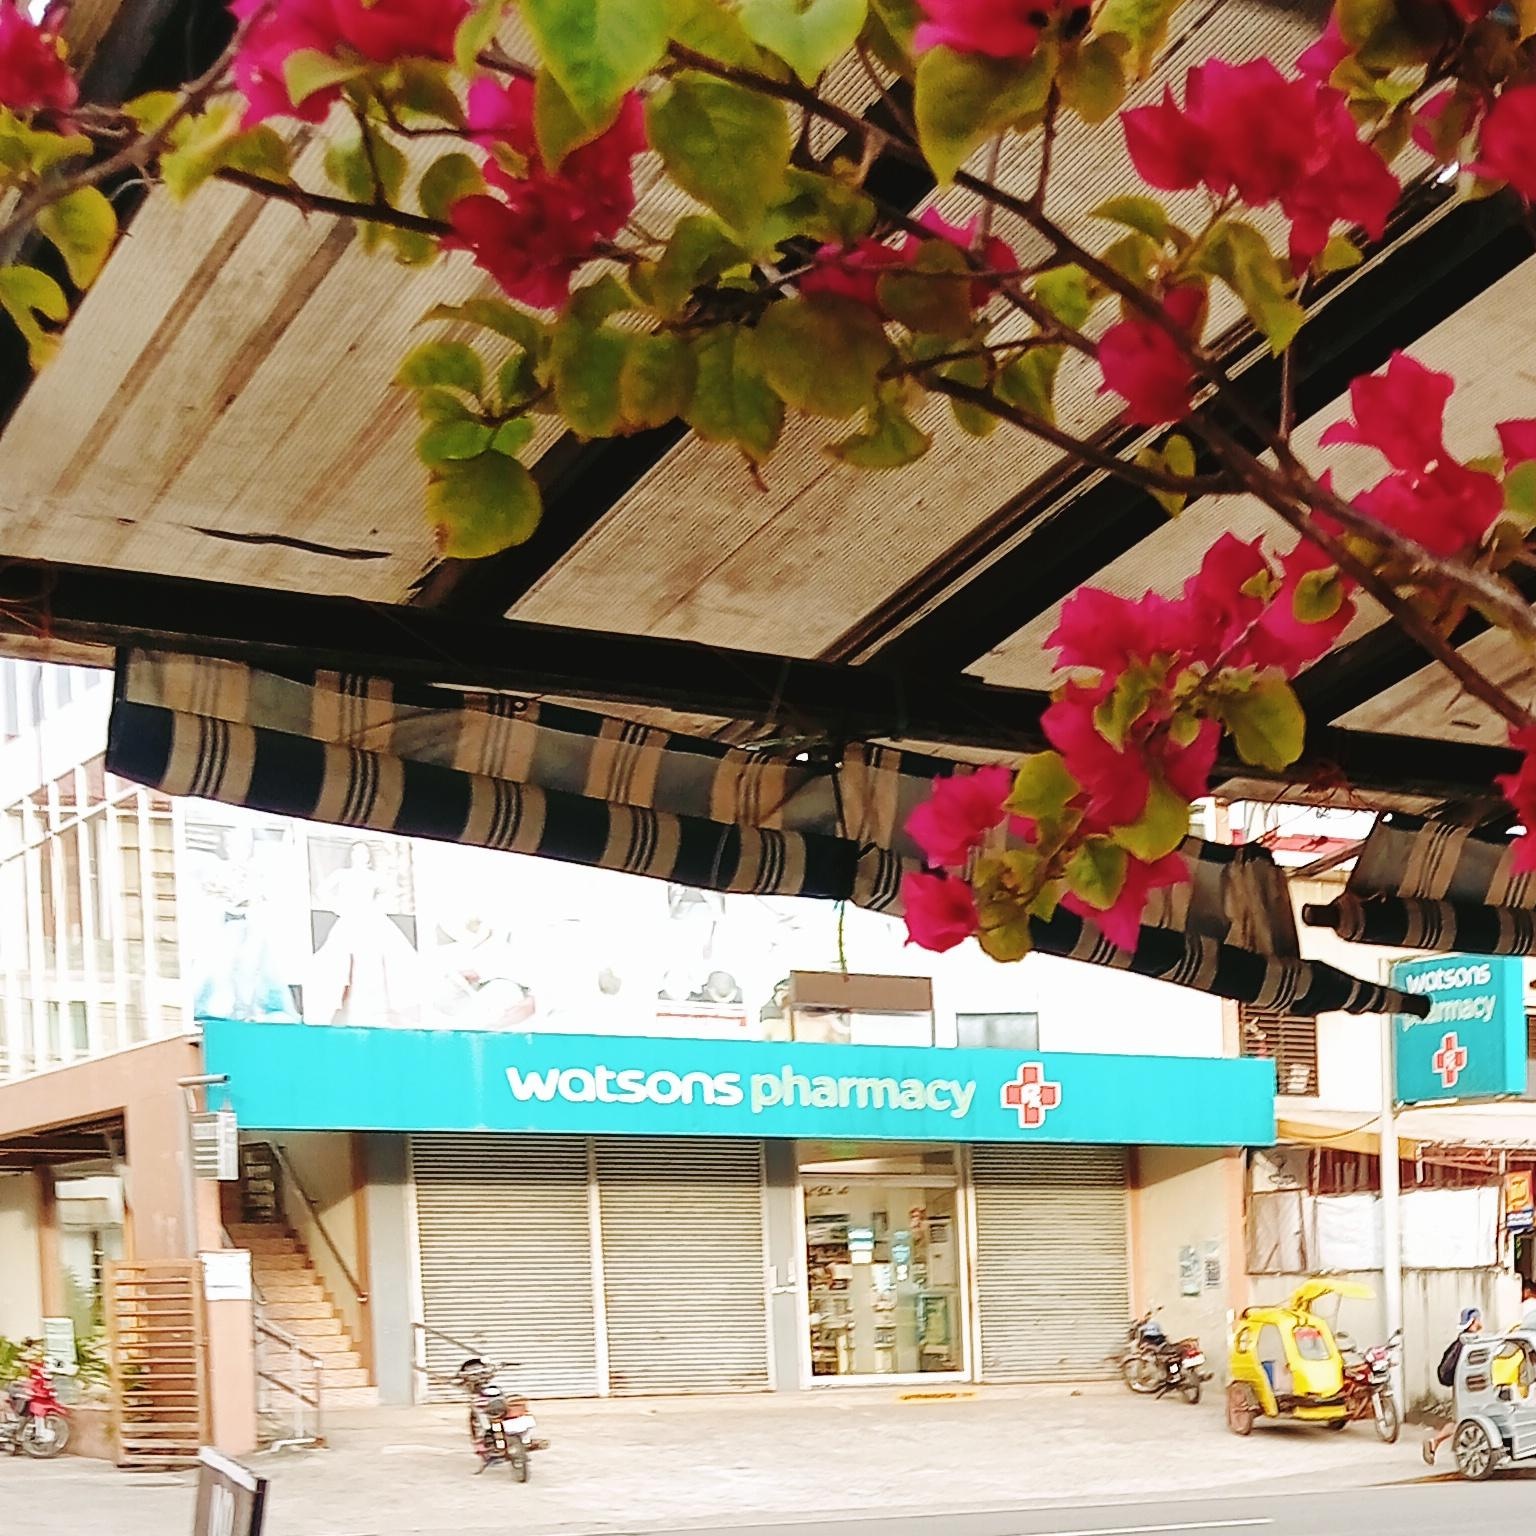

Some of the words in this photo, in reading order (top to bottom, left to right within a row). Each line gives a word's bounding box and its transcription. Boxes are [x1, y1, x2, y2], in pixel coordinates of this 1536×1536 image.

[1405, 963, 1492, 994] watsons
[506, 1065, 742, 1104] watsons
[750, 1063, 976, 1118] pharmacy
